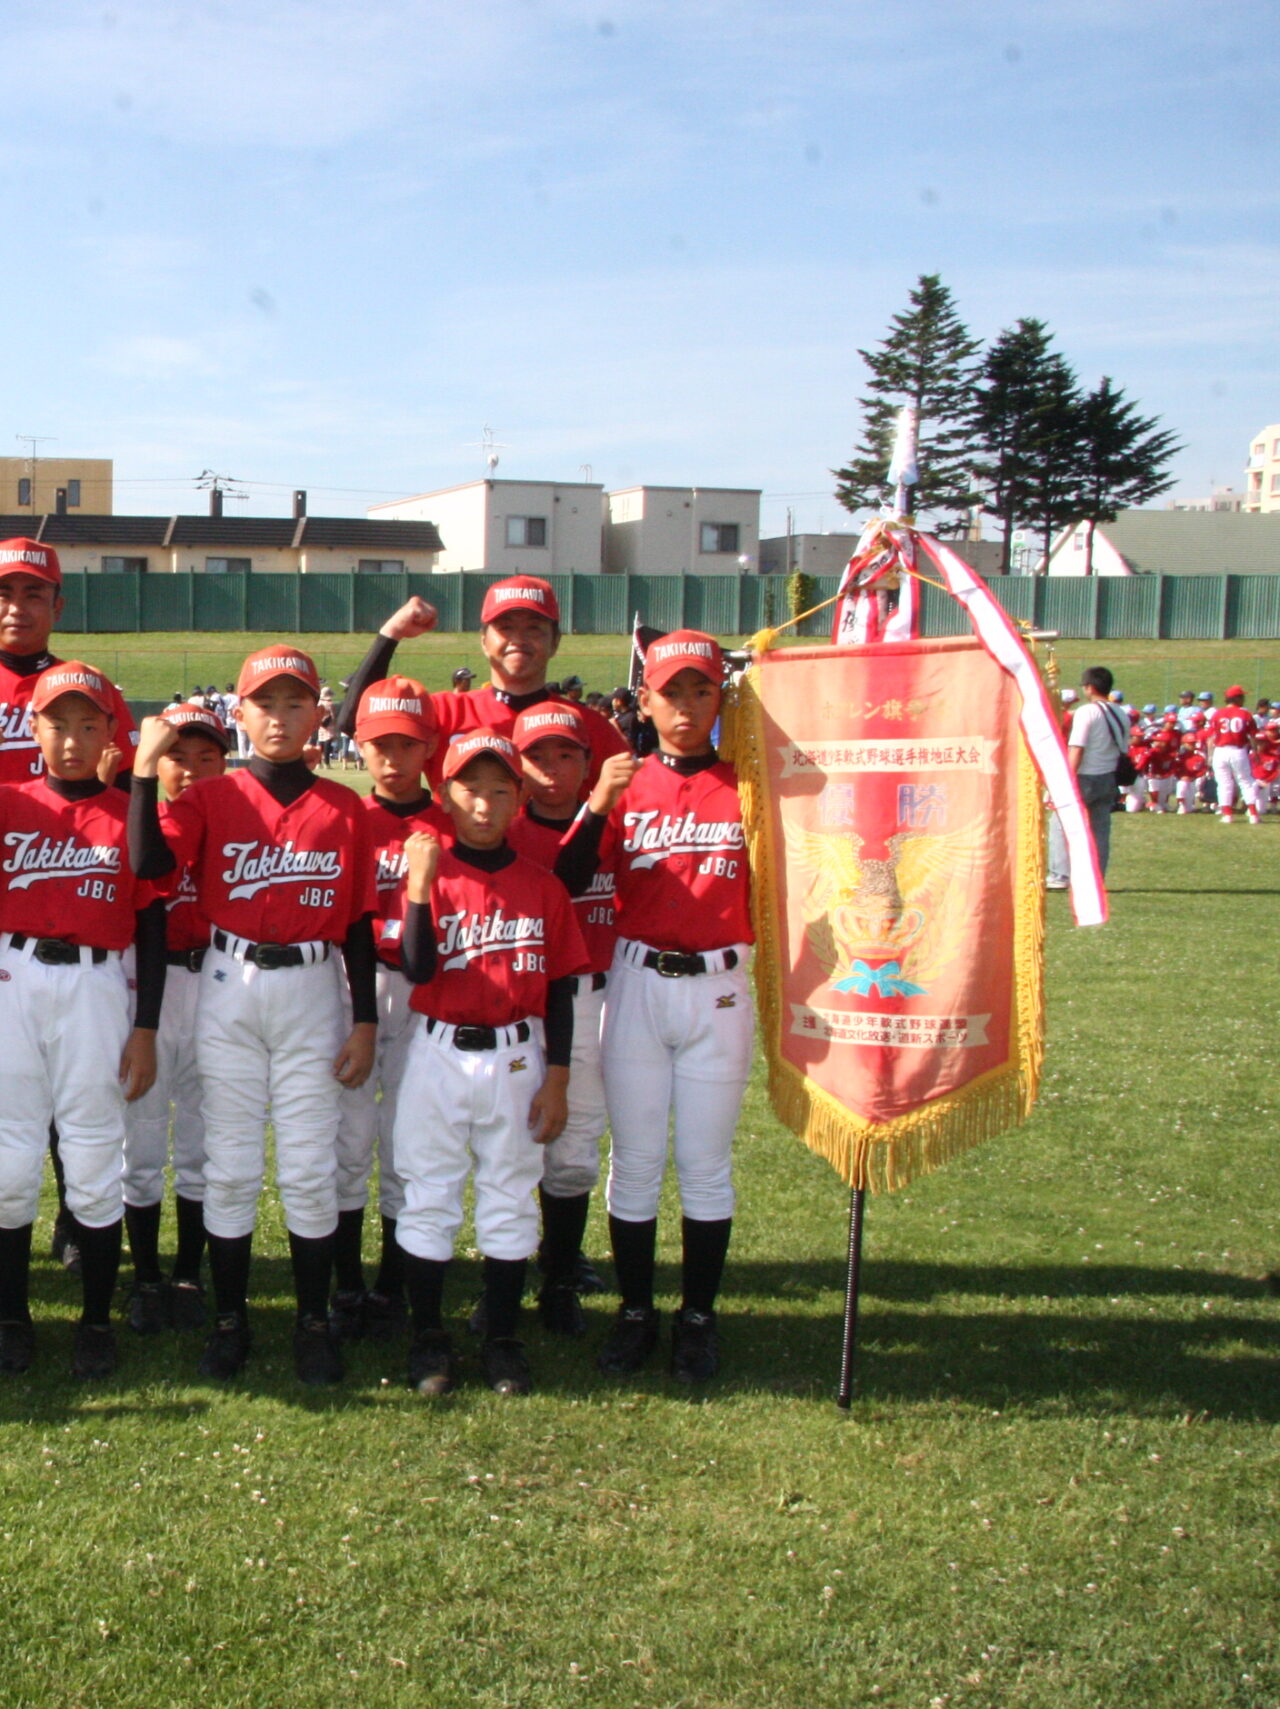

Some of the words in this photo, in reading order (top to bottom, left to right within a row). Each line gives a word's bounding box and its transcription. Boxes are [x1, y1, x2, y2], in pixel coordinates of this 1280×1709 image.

[493, 587, 545, 604] TAKIKAWA
[654, 641, 713, 662] TAKIKAWA
[251, 657, 310, 675] TAKIKAWA
[45, 672, 102, 692] TAKIKAWA
[369, 696, 423, 716] TAKIKAWA
[523, 712, 577, 732] TAKIKAWA
[1219, 716, 1244, 734] 30
[456, 735, 514, 756] TAKIKAWA
[623, 810, 744, 858] Takikawa
[2, 831, 120, 878] Takikawa
[222, 840, 342, 889] Takikawa
[699, 856, 738, 879] JBC
[77, 879, 116, 902] JBC
[299, 886, 335, 908] JBC
[588, 906, 615, 926] JBC
[437, 909, 545, 960] Takikawa
